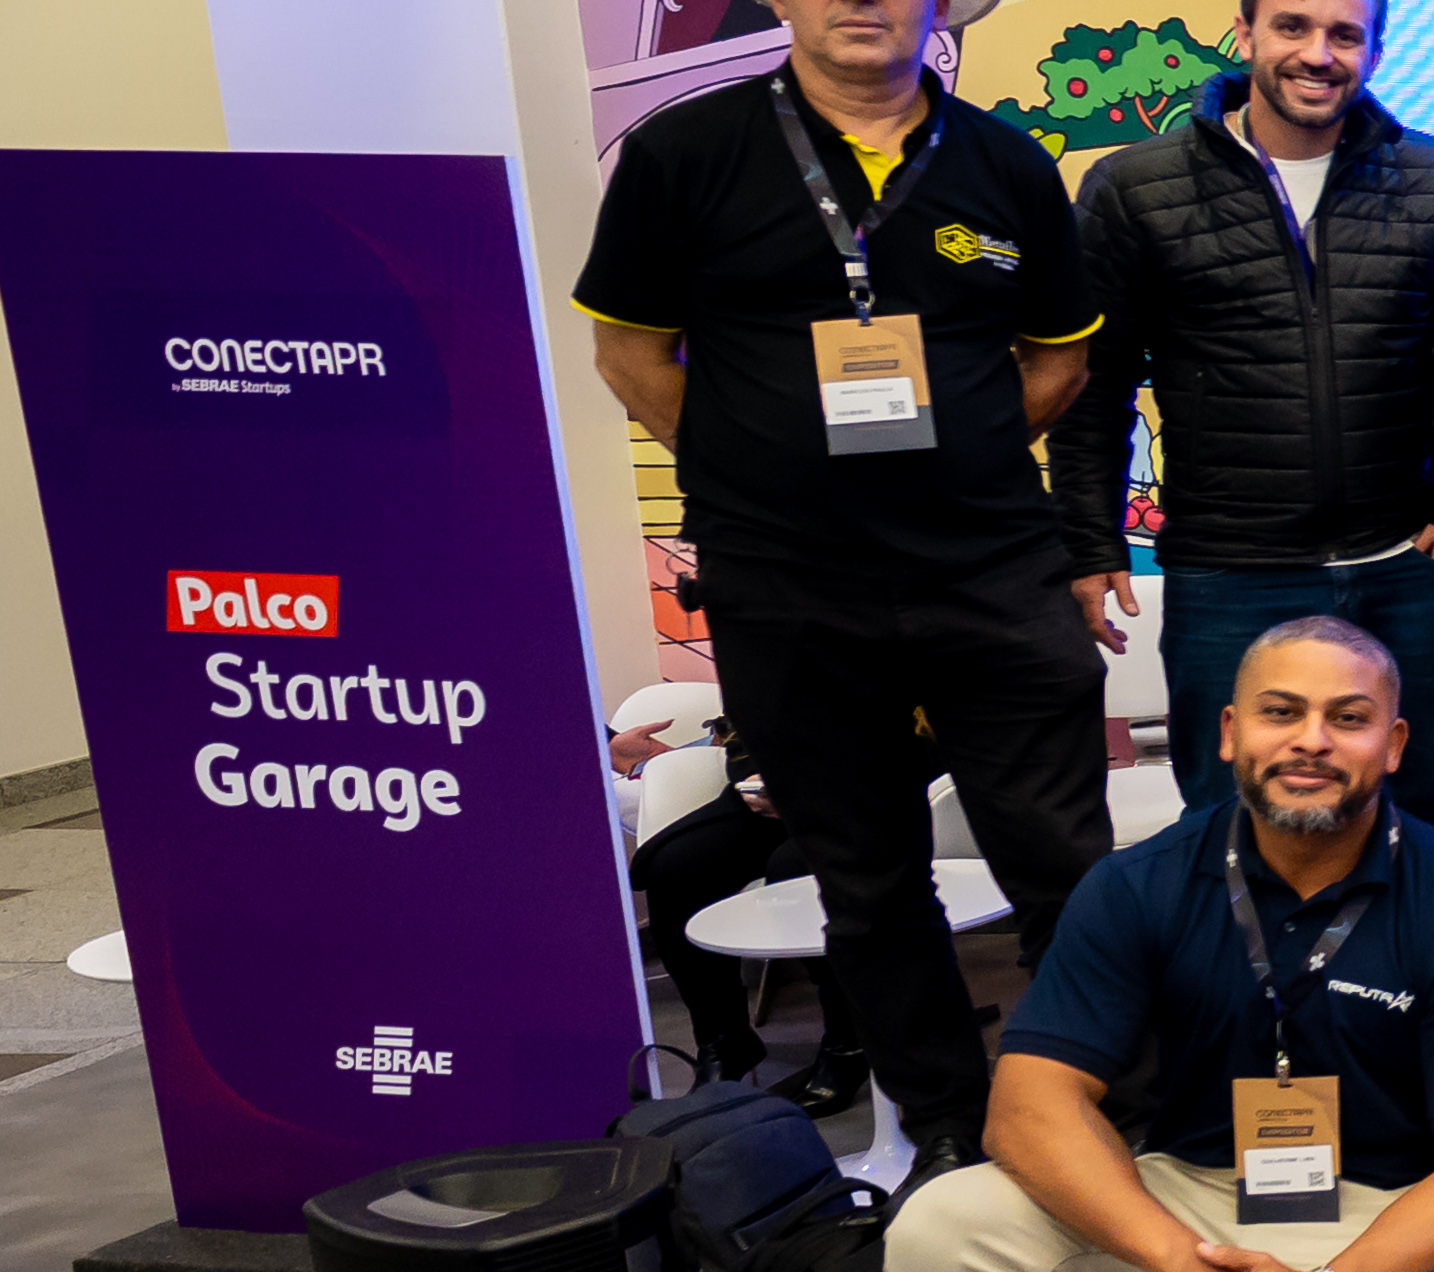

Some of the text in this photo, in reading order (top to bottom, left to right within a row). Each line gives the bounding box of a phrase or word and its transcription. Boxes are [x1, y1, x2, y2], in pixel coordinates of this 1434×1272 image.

[165, 338, 386, 377] CONECTAPR
[181, 379, 239, 393] SEBRAE
[241, 381, 291, 397] Startups
[176, 577, 328, 631] Palco
[206, 653, 484, 744] Startup
[194, 743, 461, 832] Garage
[336, 1046, 453, 1075] SEBRAE
